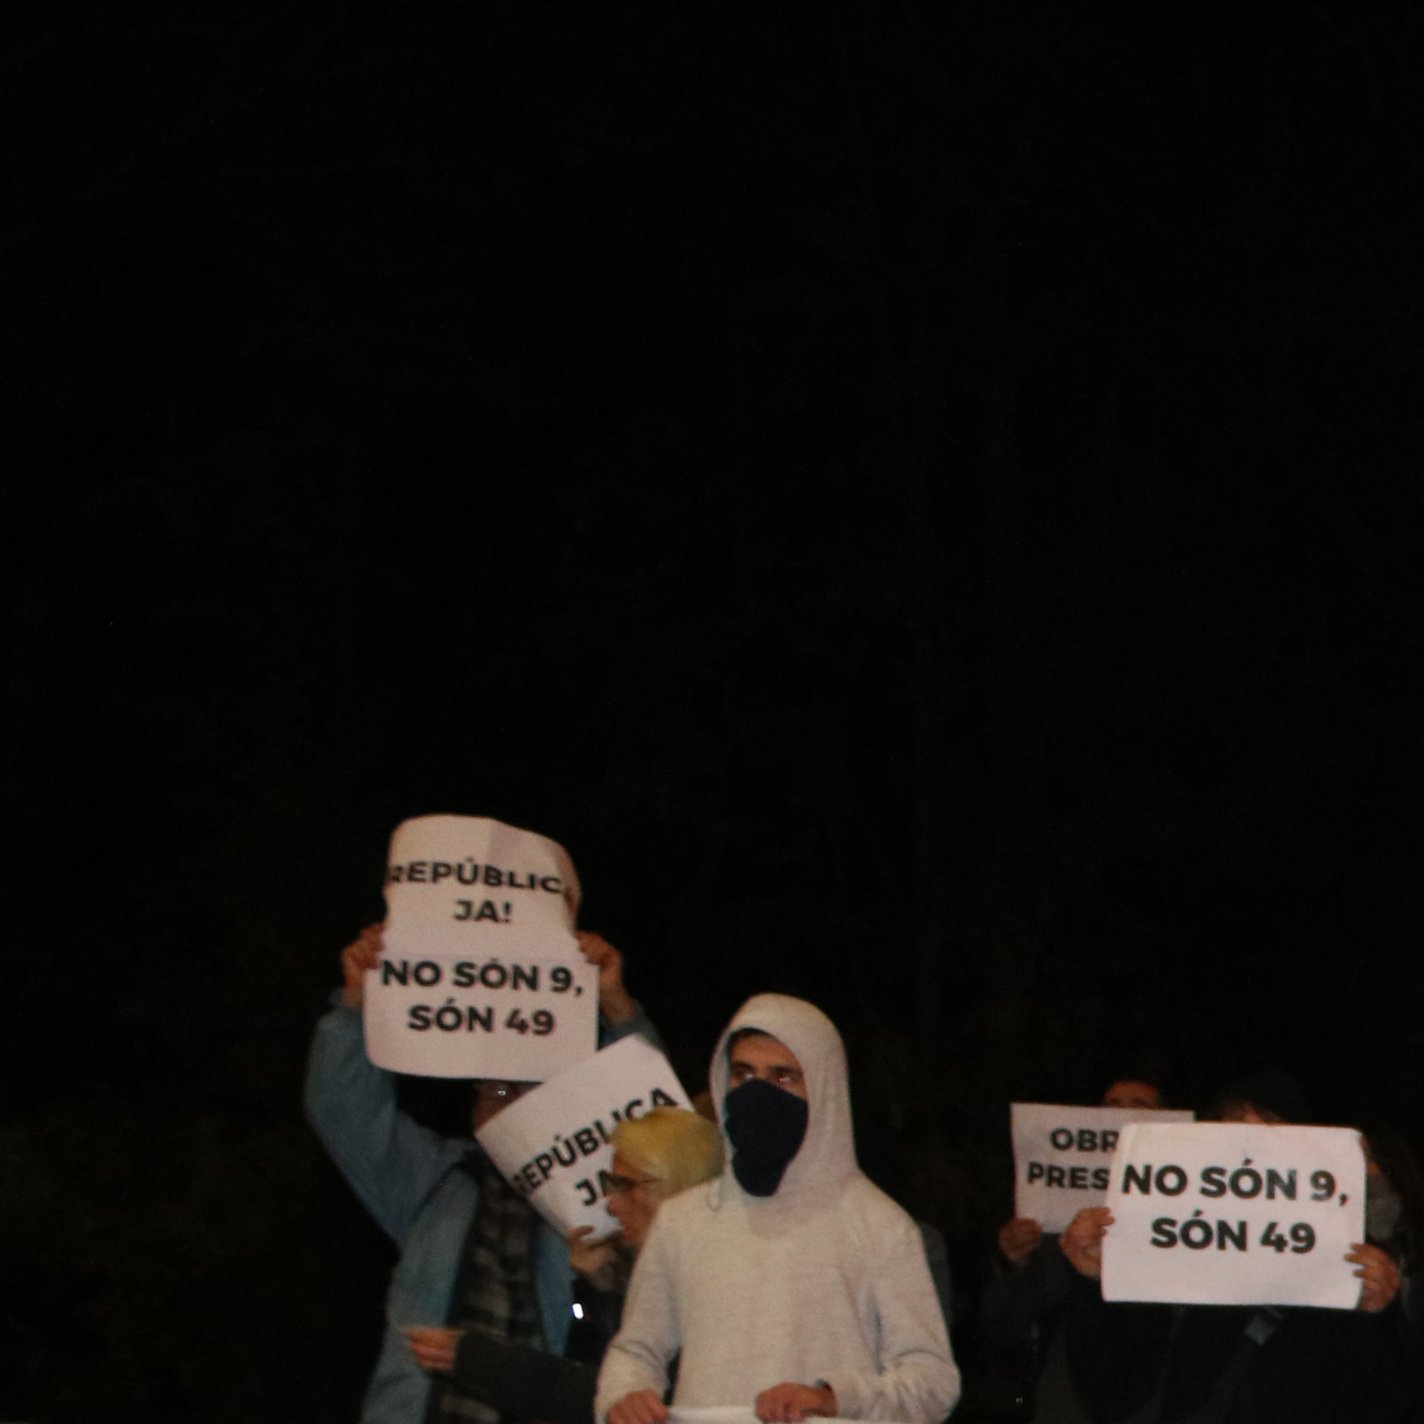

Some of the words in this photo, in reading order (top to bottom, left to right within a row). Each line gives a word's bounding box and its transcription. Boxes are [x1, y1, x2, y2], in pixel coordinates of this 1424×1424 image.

[454, 899, 511, 923] JA!
[381, 959, 441, 986] NO
[453, 957, 539, 991] SÓN
[551, 965, 583, 996] 9,
[408, 997, 493, 1032] SÓN
[505, 1008, 554, 1035] 49
[1121, 1164, 1187, 1197] NO
[1200, 1157, 1297, 1200] SÓN
[1309, 1170, 1348, 1207] 9,
[1150, 1209, 1247, 1252] SÓN
[1259, 1221, 1317, 1255] 49
